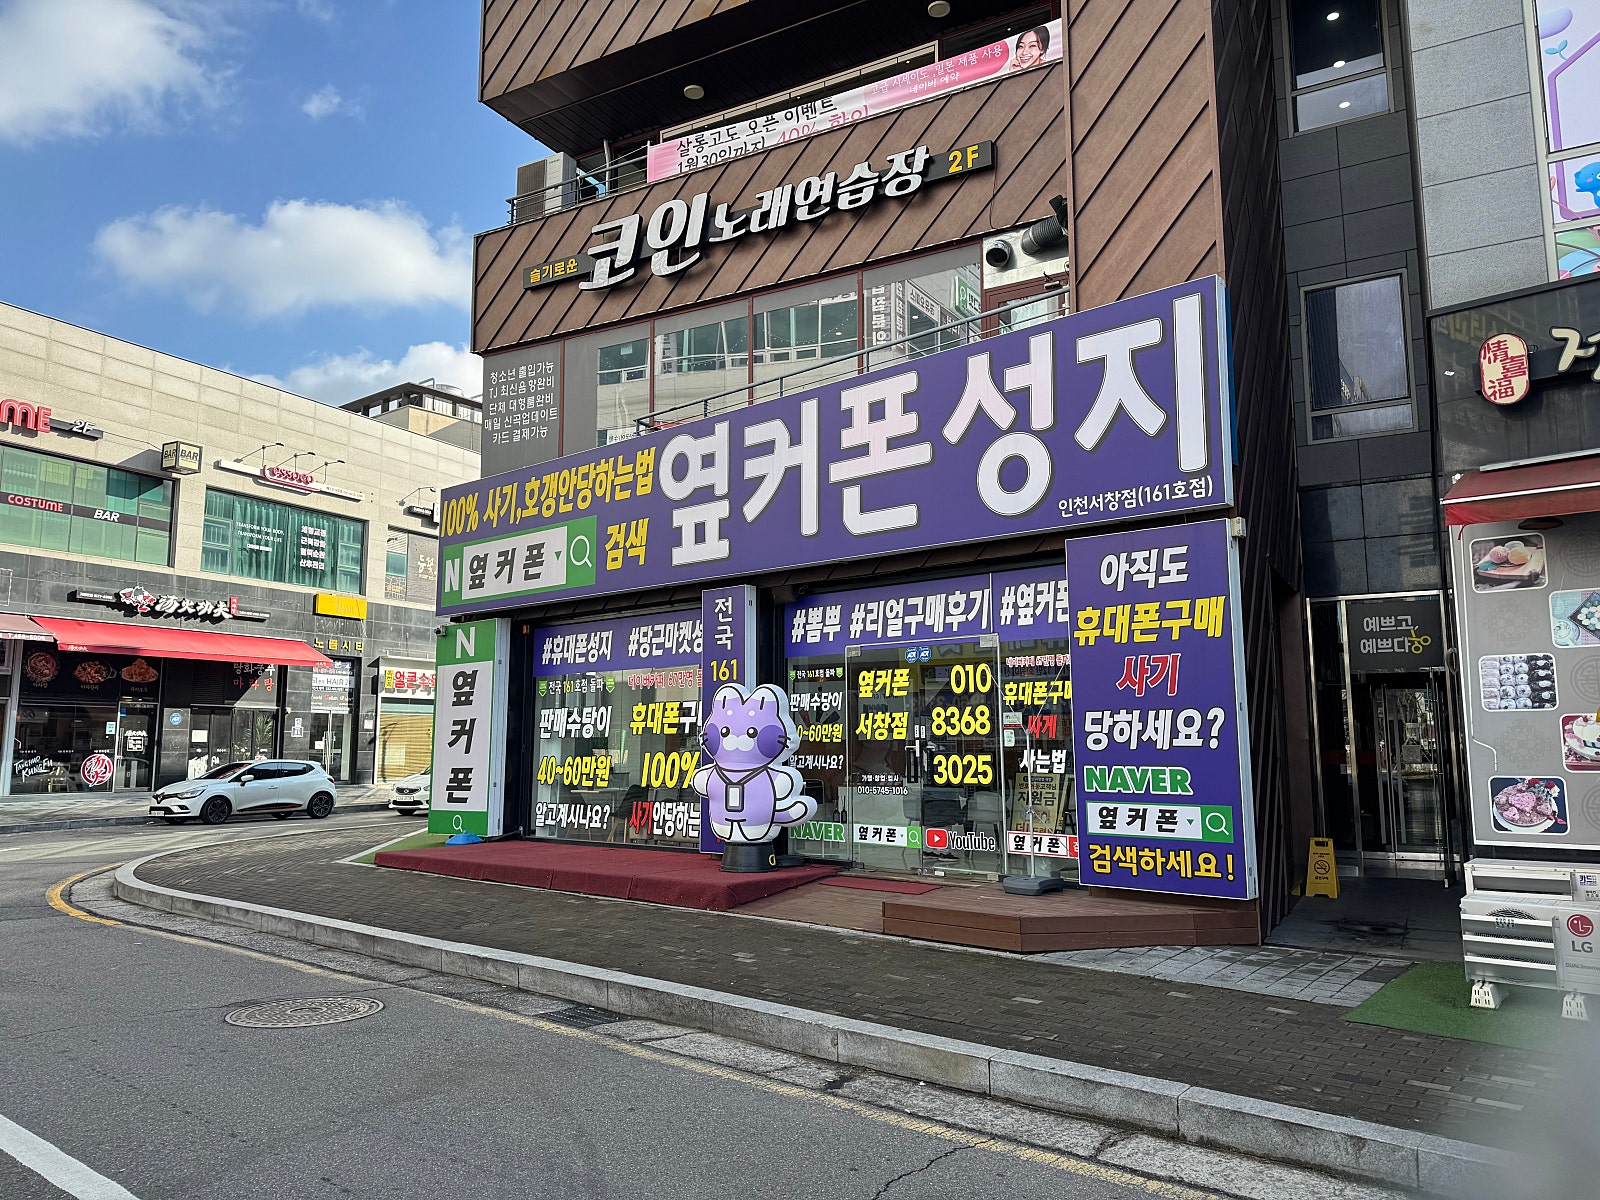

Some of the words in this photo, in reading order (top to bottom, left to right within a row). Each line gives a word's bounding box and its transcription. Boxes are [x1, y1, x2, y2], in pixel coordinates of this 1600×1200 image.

[982, 44, 1003, 59] 사용
[676, 125, 741, 157] 살롱고도
[746, 113, 779, 137] 오픈
[784, 96, 837, 124] 이벤트
[528, 258, 578, 284] 슬기로운
[948, 145, 980, 174] 2F
[490, 367, 516, 385] 청소년
[518, 361, 554, 379] 출입가능
[484, 417, 501, 431] 매일
[489, 401, 506, 416] 단체
[72, 419, 96, 434] 2F
[492, 430, 510, 445] 카드
[512, 425, 549, 442] 결제가능
[163, 448, 177, 459] BAR
[179, 449, 199, 461] BAR
[7, 494, 64, 512] COSTUME
[94, 509, 120, 522] BAR
[440, 491, 480, 538] 100%
[482, 446, 657, 529] 사기,호갱안당하는법
[1058, 475, 1214, 519] 인천서창점(161호점)
[604, 517, 650, 572] 검색
[1100, 545, 1189, 592] 아직도
[714, 596, 734, 650] 전국
[791, 604, 842, 644] #뽐뿌
[849, 588, 991, 639] #리얼구매후기
[1073, 595, 1227, 647] 휴대폰구매
[455, 626, 476, 659] N
[541, 629, 614, 666] #휴대폰성지
[710, 658, 738, 682] 161
[858, 668, 911, 698] 옆커폰
[950, 663, 992, 695] 010
[1116, 652, 1182, 697] 사기
[548, 680, 562, 695] 전국
[789, 691, 844, 713] 판매수당이
[539, 705, 612, 739] 판매수당이
[629, 700, 702, 735] 휴대폰구
[797, 723, 844, 743] 0~60만원
[855, 711, 909, 741] 서창점
[931, 704, 991, 736] 8368
[1084, 706, 1226, 751] 당하세요?
[537, 755, 612, 788] 40~60만원
[640, 751, 701, 789] 100%
[932, 754, 993, 786] 3025
[1083, 765, 1194, 796] NAVER
[535, 801, 611, 830] 알고계시나요?
[790, 821, 846, 842] NAVER
[948, 830, 996, 852] YouTube
[1088, 844, 1237, 881] 검색하세요!
[1571, 940, 1594, 954] LG
